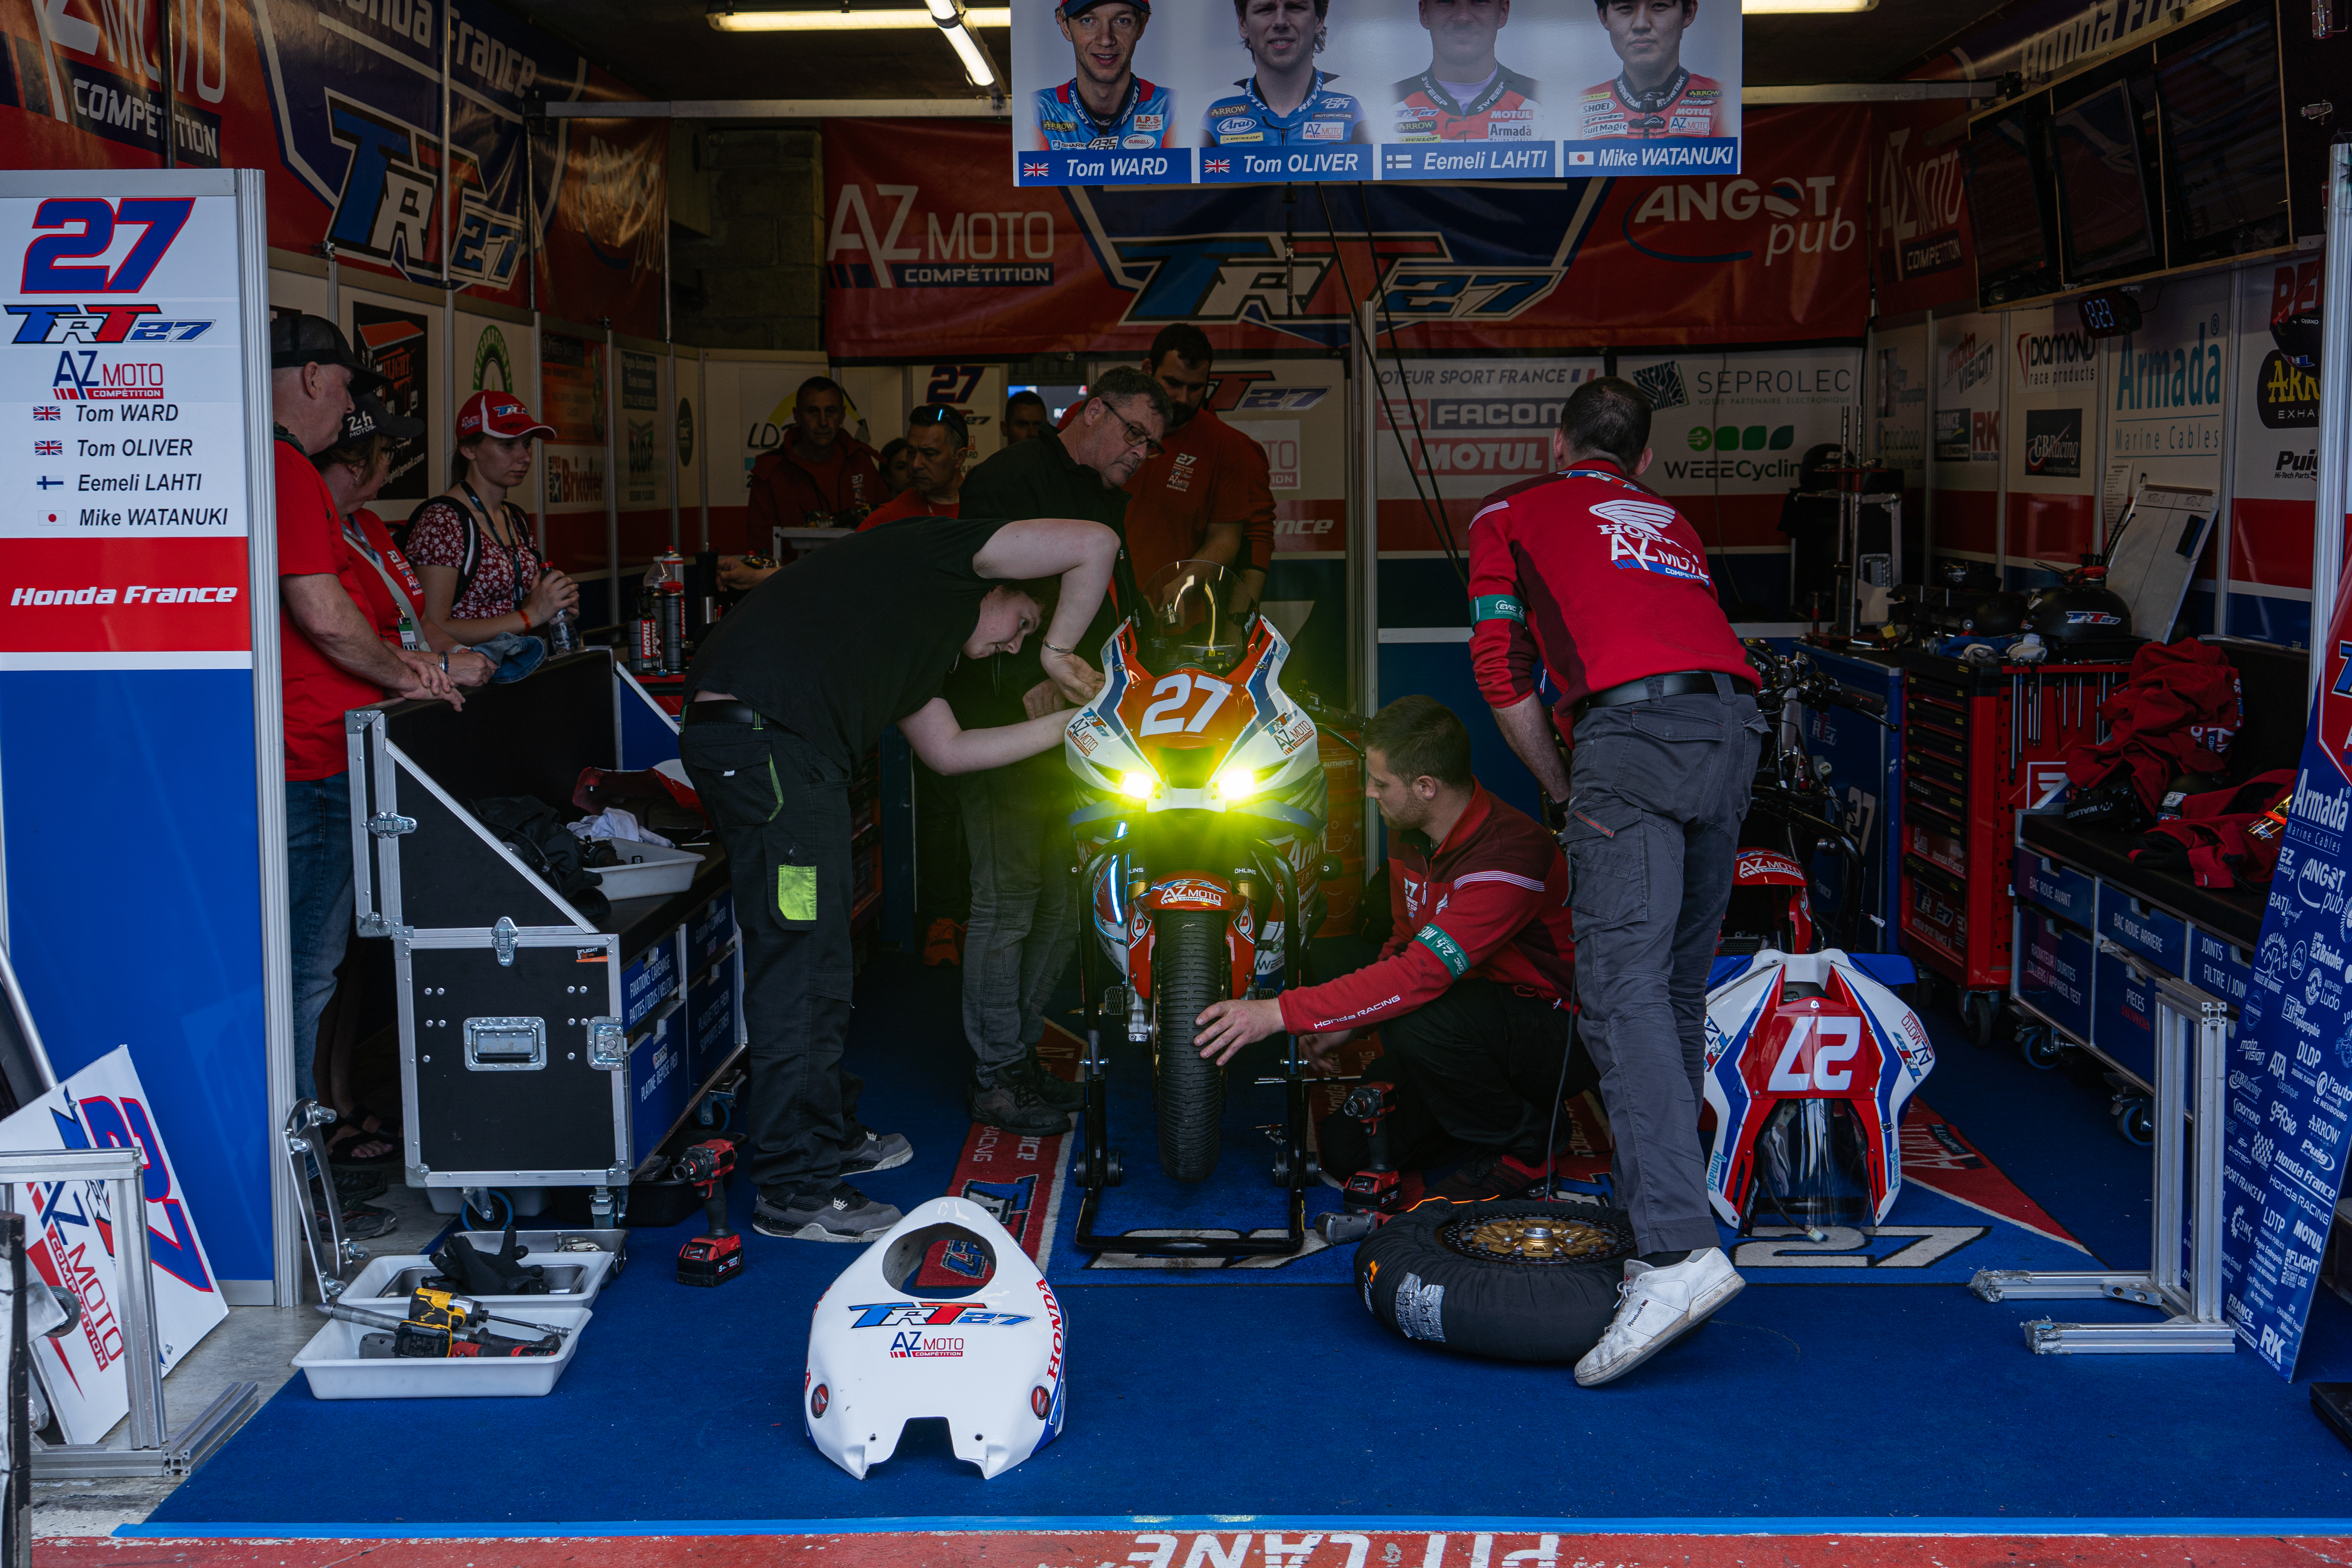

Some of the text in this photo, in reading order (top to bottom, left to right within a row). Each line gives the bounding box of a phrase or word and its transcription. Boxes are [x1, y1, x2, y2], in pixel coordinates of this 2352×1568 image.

[1421, 76, 1448, 106] SWEEP
[1477, 81, 1504, 113] SWEEP
[1070, 90, 1089, 124] ARCON
[1121, 85, 1139, 125] ARCON
[1211, 106, 1246, 116] ARROW
[1583, 103, 1610, 113] SHOEI
[1044, 121, 1074, 129] ARROW
[1225, 120, 1250, 129] Arai
[1305, 124, 1320, 138] AZ
[1490, 123, 1532, 136] Armada
[1600, 123, 1627, 132] Magic
[1671, 118, 1687, 132] AZ
[1067, 158, 1168, 176] Tom WARD
[1244, 154, 1358, 173] Tom OLIVER
[1424, 151, 1547, 170] Eemeli LAHTI
[1599, 147, 1733, 166] Mike WATANUKI
[20, 198, 196, 294] 27
[826, 183, 1054, 289] AZ MOTO
[1765, 207, 1857, 267] pub
[904, 265, 1049, 283] COMPÉTITION
[1374, 267, 1569, 321] 27
[3, 304, 216, 343] TRT 27
[1947, 331, 1976, 379] moto
[53, 351, 163, 395] AZ MOTO
[926, 365, 985, 403] 27
[1440, 369, 1494, 384] SPORT
[1499, 368, 1567, 383] FRANCE
[1698, 369, 1850, 393] SEPROLEC
[2030, 367, 2094, 387] race products
[93, 388, 161, 397] COMPÉTITION
[1236, 386, 1332, 411] 27
[76, 404, 178, 422] Tom WARD
[347, 410, 373, 432] 24h
[349, 425, 374, 438] MOTOS
[1972, 411, 1999, 452] RK
[2116, 423, 2218, 451] Marine Cables
[78, 439, 192, 456] Tom OLIVER
[1176, 453, 1198, 466] 27
[1417, 443, 1544, 470] MOTUL
[2034, 434, 2078, 465] GBRacing
[78, 474, 201, 491] Eemeli LAHTI
[80, 508, 227, 526] Mike WATANUKI
[11, 586, 237, 606] Honda France
[643, 622, 651, 656] MOTUL
[1139, 673, 1233, 737] 27
[1323, 758, 1354, 768] AUTHENTIC
[2287, 822, 2340, 853] Marine Cables
[1766, 861, 1801, 876] MOTO
[2279, 846, 2295, 866] EZ
[1187, 889, 1221, 902] MOTO
[2029, 877, 2071, 907] BAC ROUE AVANT
[2321, 889, 2344, 914] pub
[2114, 913, 2163, 953] BAC ROUE ARRIERE
[2201, 937, 2223, 961] JOINTS
[2319, 944, 2344, 971] Bricofer
[2204, 964, 2225, 989] FILTRE
[2324, 979, 2343, 995] AUTO-ECOLE
[1314, 995, 1401, 1029] Honda RACING
[2127, 988, 2144, 1012] PIECES
[2295, 1000, 2307, 1019] Bray
[2320, 988, 2339, 1011] Ludo
[2122, 1004, 2150, 1032] HONDA
[2292, 1014, 2320, 1038] Topographie
[1768, 1016, 1861, 1091] 27
[2240, 1039, 2258, 1050] moto
[2296, 1040, 2321, 1069] DLDP
[2267, 1051, 2287, 1080] ATA
[2235, 1070, 2262, 1099] GBRacing
[2278, 1078, 2298, 1099] Logistique
[2313, 1096, 2347, 1122] LE NEUBOURG
[2308, 1114, 2341, 1145] ARROW
[2228, 1144, 2252, 1165] EVOTECH
[2301, 1139, 2329, 1165] Puig
[1707, 1150, 1727, 1192] Armada
[2223, 1165, 2257, 1198] SPORT FRANCE
[2275, 1150, 2336, 1200] Honda France
[2269, 1174, 2330, 1225] Honda RACING
[2263, 1206, 2285, 1234] LDTP
[1729, 1225, 1992, 1269] 27
[2293, 1220, 2323, 1253] MOTUL
[2289, 1250, 2319, 1274] FLIGHT
[2286, 1270, 2307, 1288] FLIGHT CASE
[67, 1242, 125, 1363] MOTO
[847, 1302, 1036, 1328] TRT 27
[2228, 1293, 2254, 1323] FRANCE
[1036, 1277, 1058, 1383] HONDA
[2293, 1319, 2303, 1333] Pascal
[890, 1331, 964, 1357] AZ MOTO
[2259, 1324, 2286, 1365] RK
